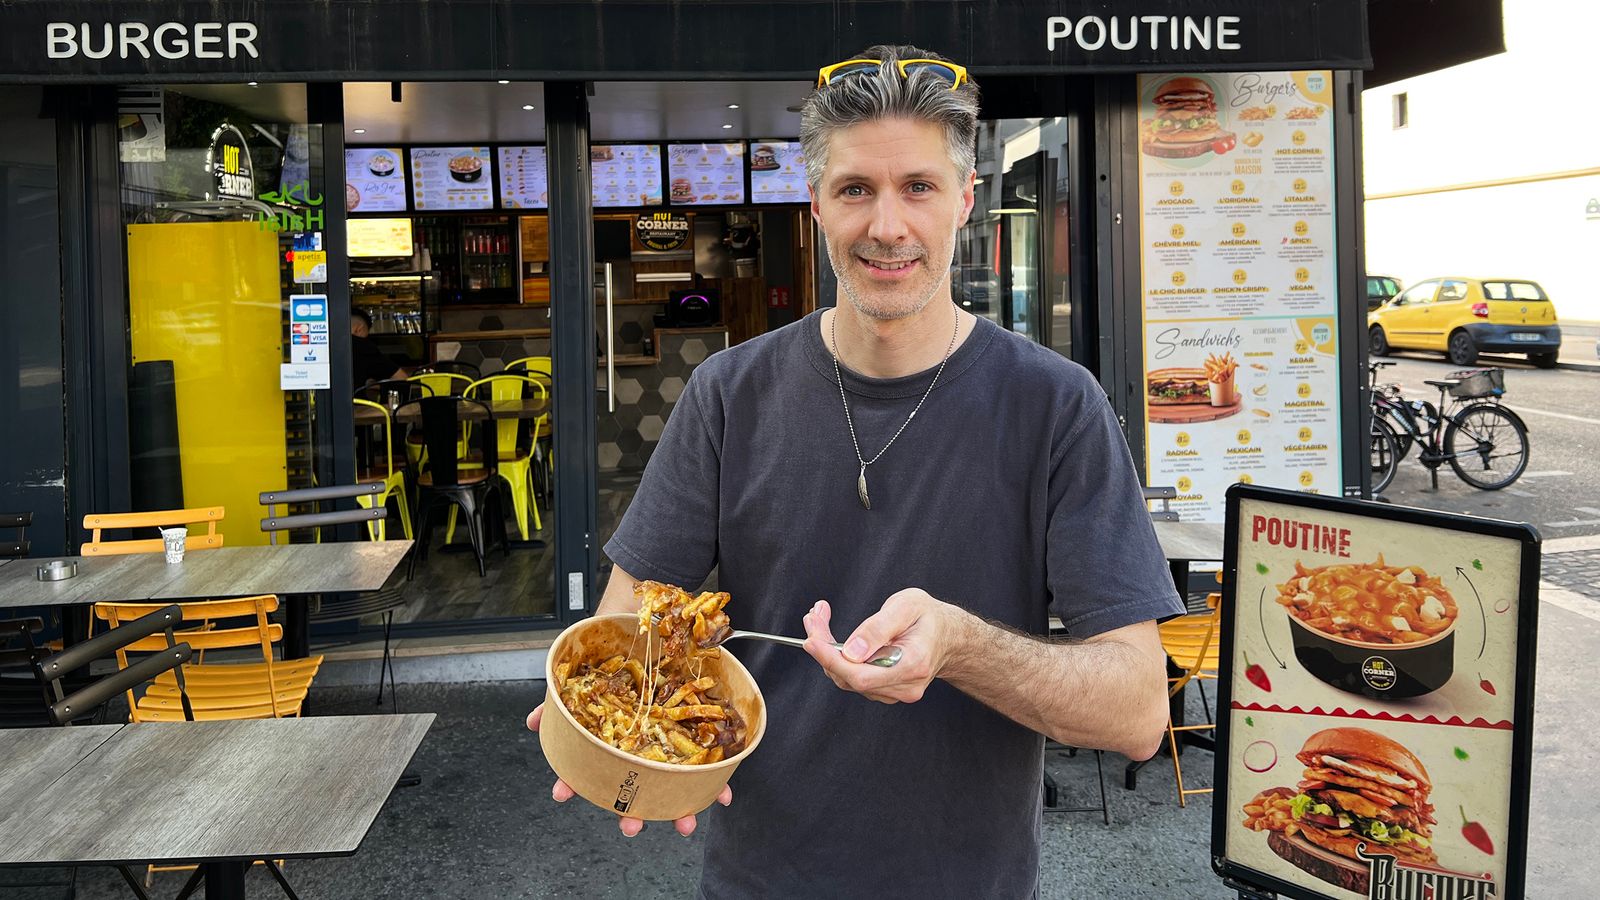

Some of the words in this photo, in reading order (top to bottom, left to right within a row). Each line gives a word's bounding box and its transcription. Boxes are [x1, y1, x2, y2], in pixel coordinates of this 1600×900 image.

[46, 22, 259, 59] BURGER
[1046, 15, 1241, 51] POUTINE
[1231, 74, 1297, 107] Burgers
[224, 144, 240, 174] HOT
[637, 220, 689, 230] CORNER
[1220, 238, 1257, 246] AMÉRICAIN
[295, 303, 323, 317] CB
[1155, 327, 1243, 360] Sandwichs
[1252, 515, 1351, 557] POUTINE
[1364, 668, 1395, 677] CORNER
